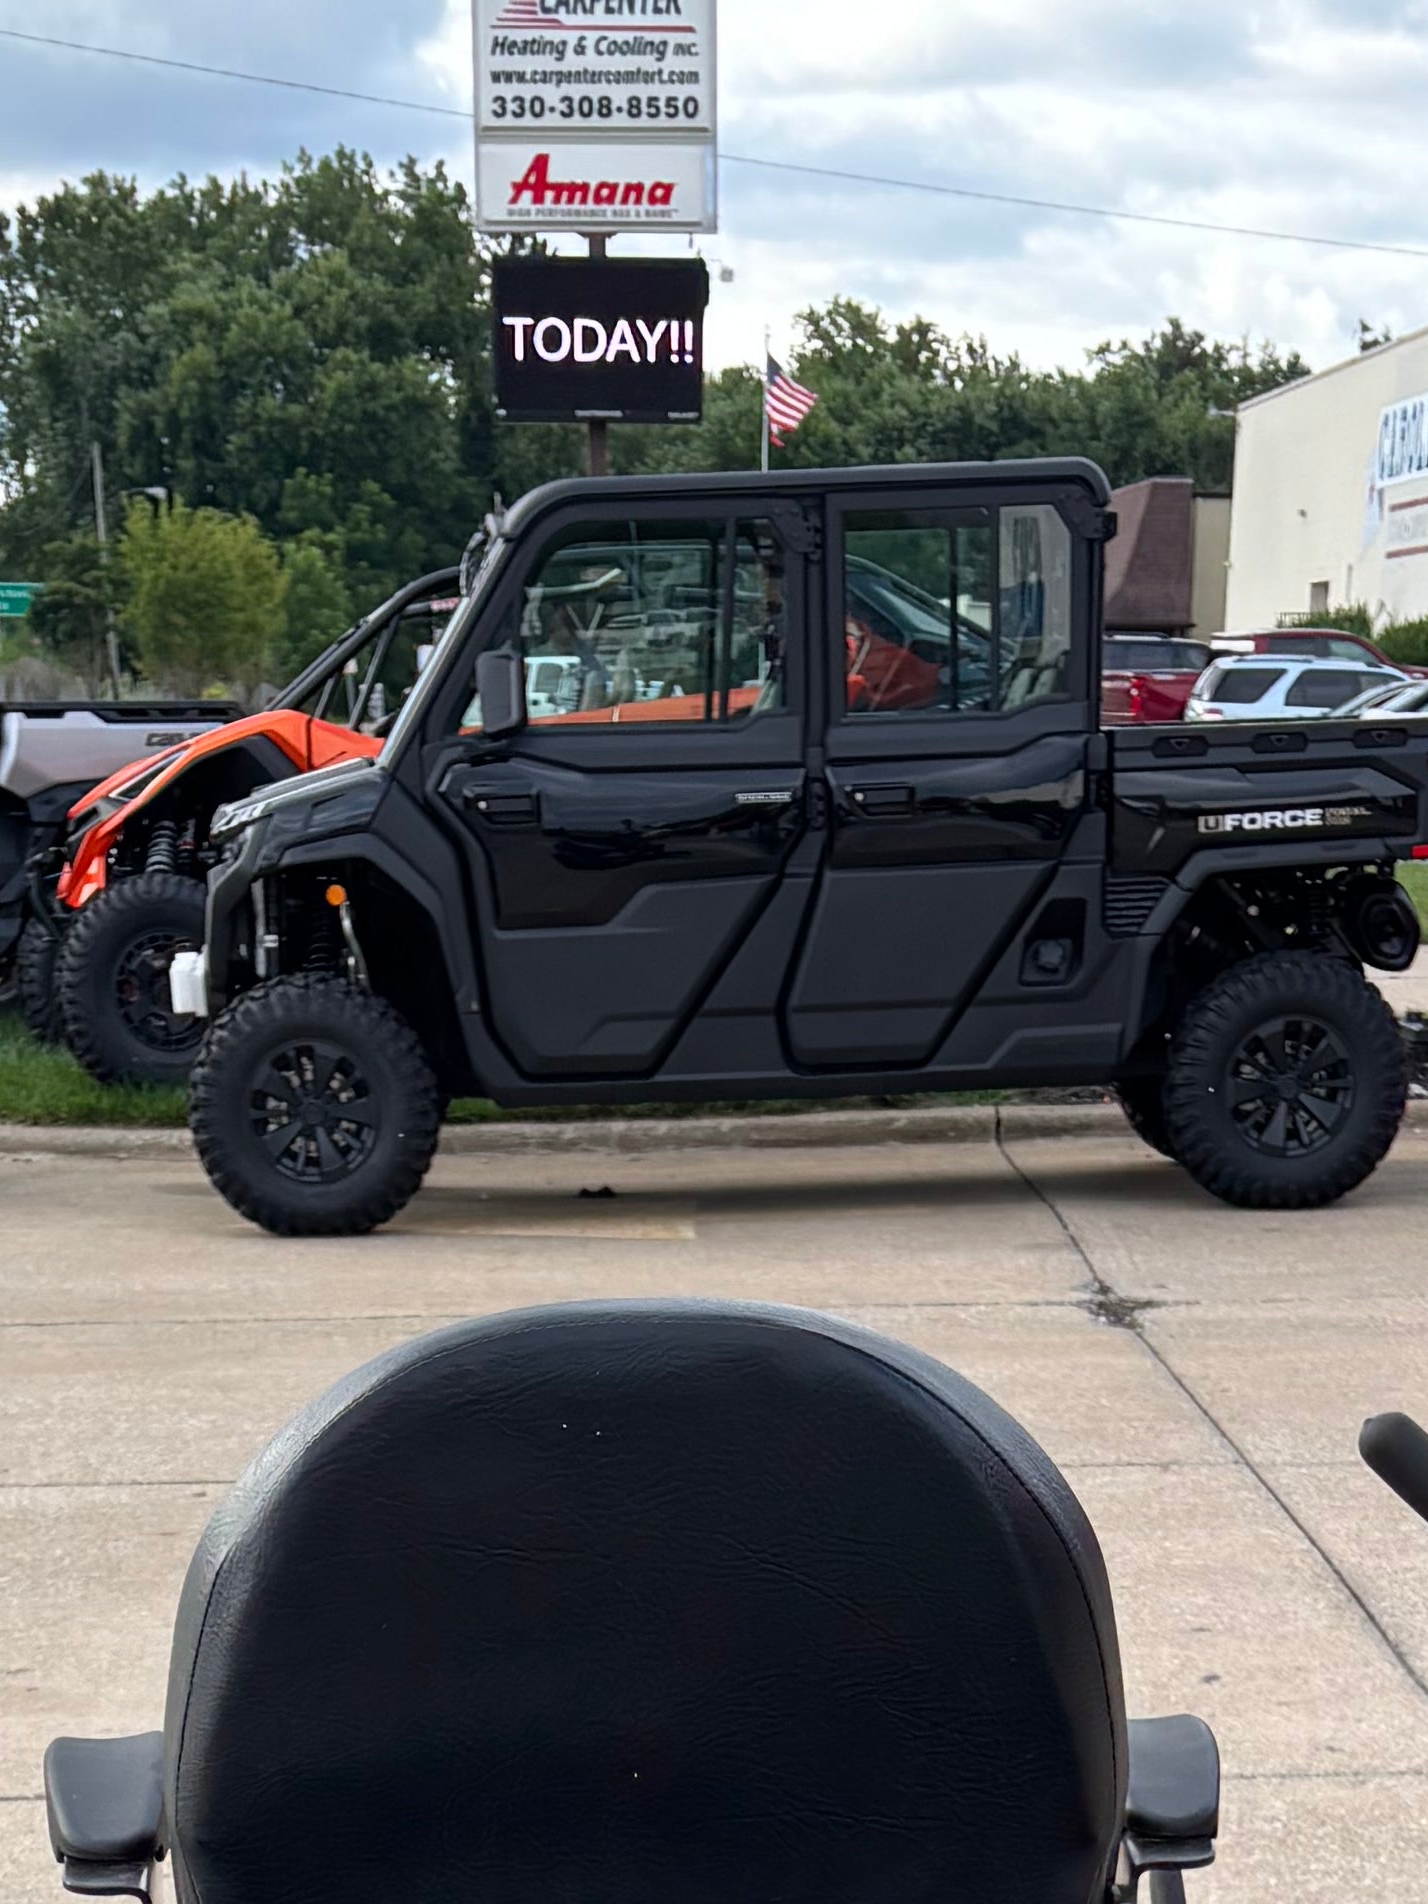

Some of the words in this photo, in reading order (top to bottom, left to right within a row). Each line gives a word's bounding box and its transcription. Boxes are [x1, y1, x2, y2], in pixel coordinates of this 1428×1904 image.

[490, 36, 568, 62] Heating
[573, 36, 586, 56] &
[594, 35, 668, 62] Cooling
[490, 67, 700, 87] www.carpentercomfort.com
[508, 153, 676, 205] Amana
[502, 316, 694, 363] TODAY!!
